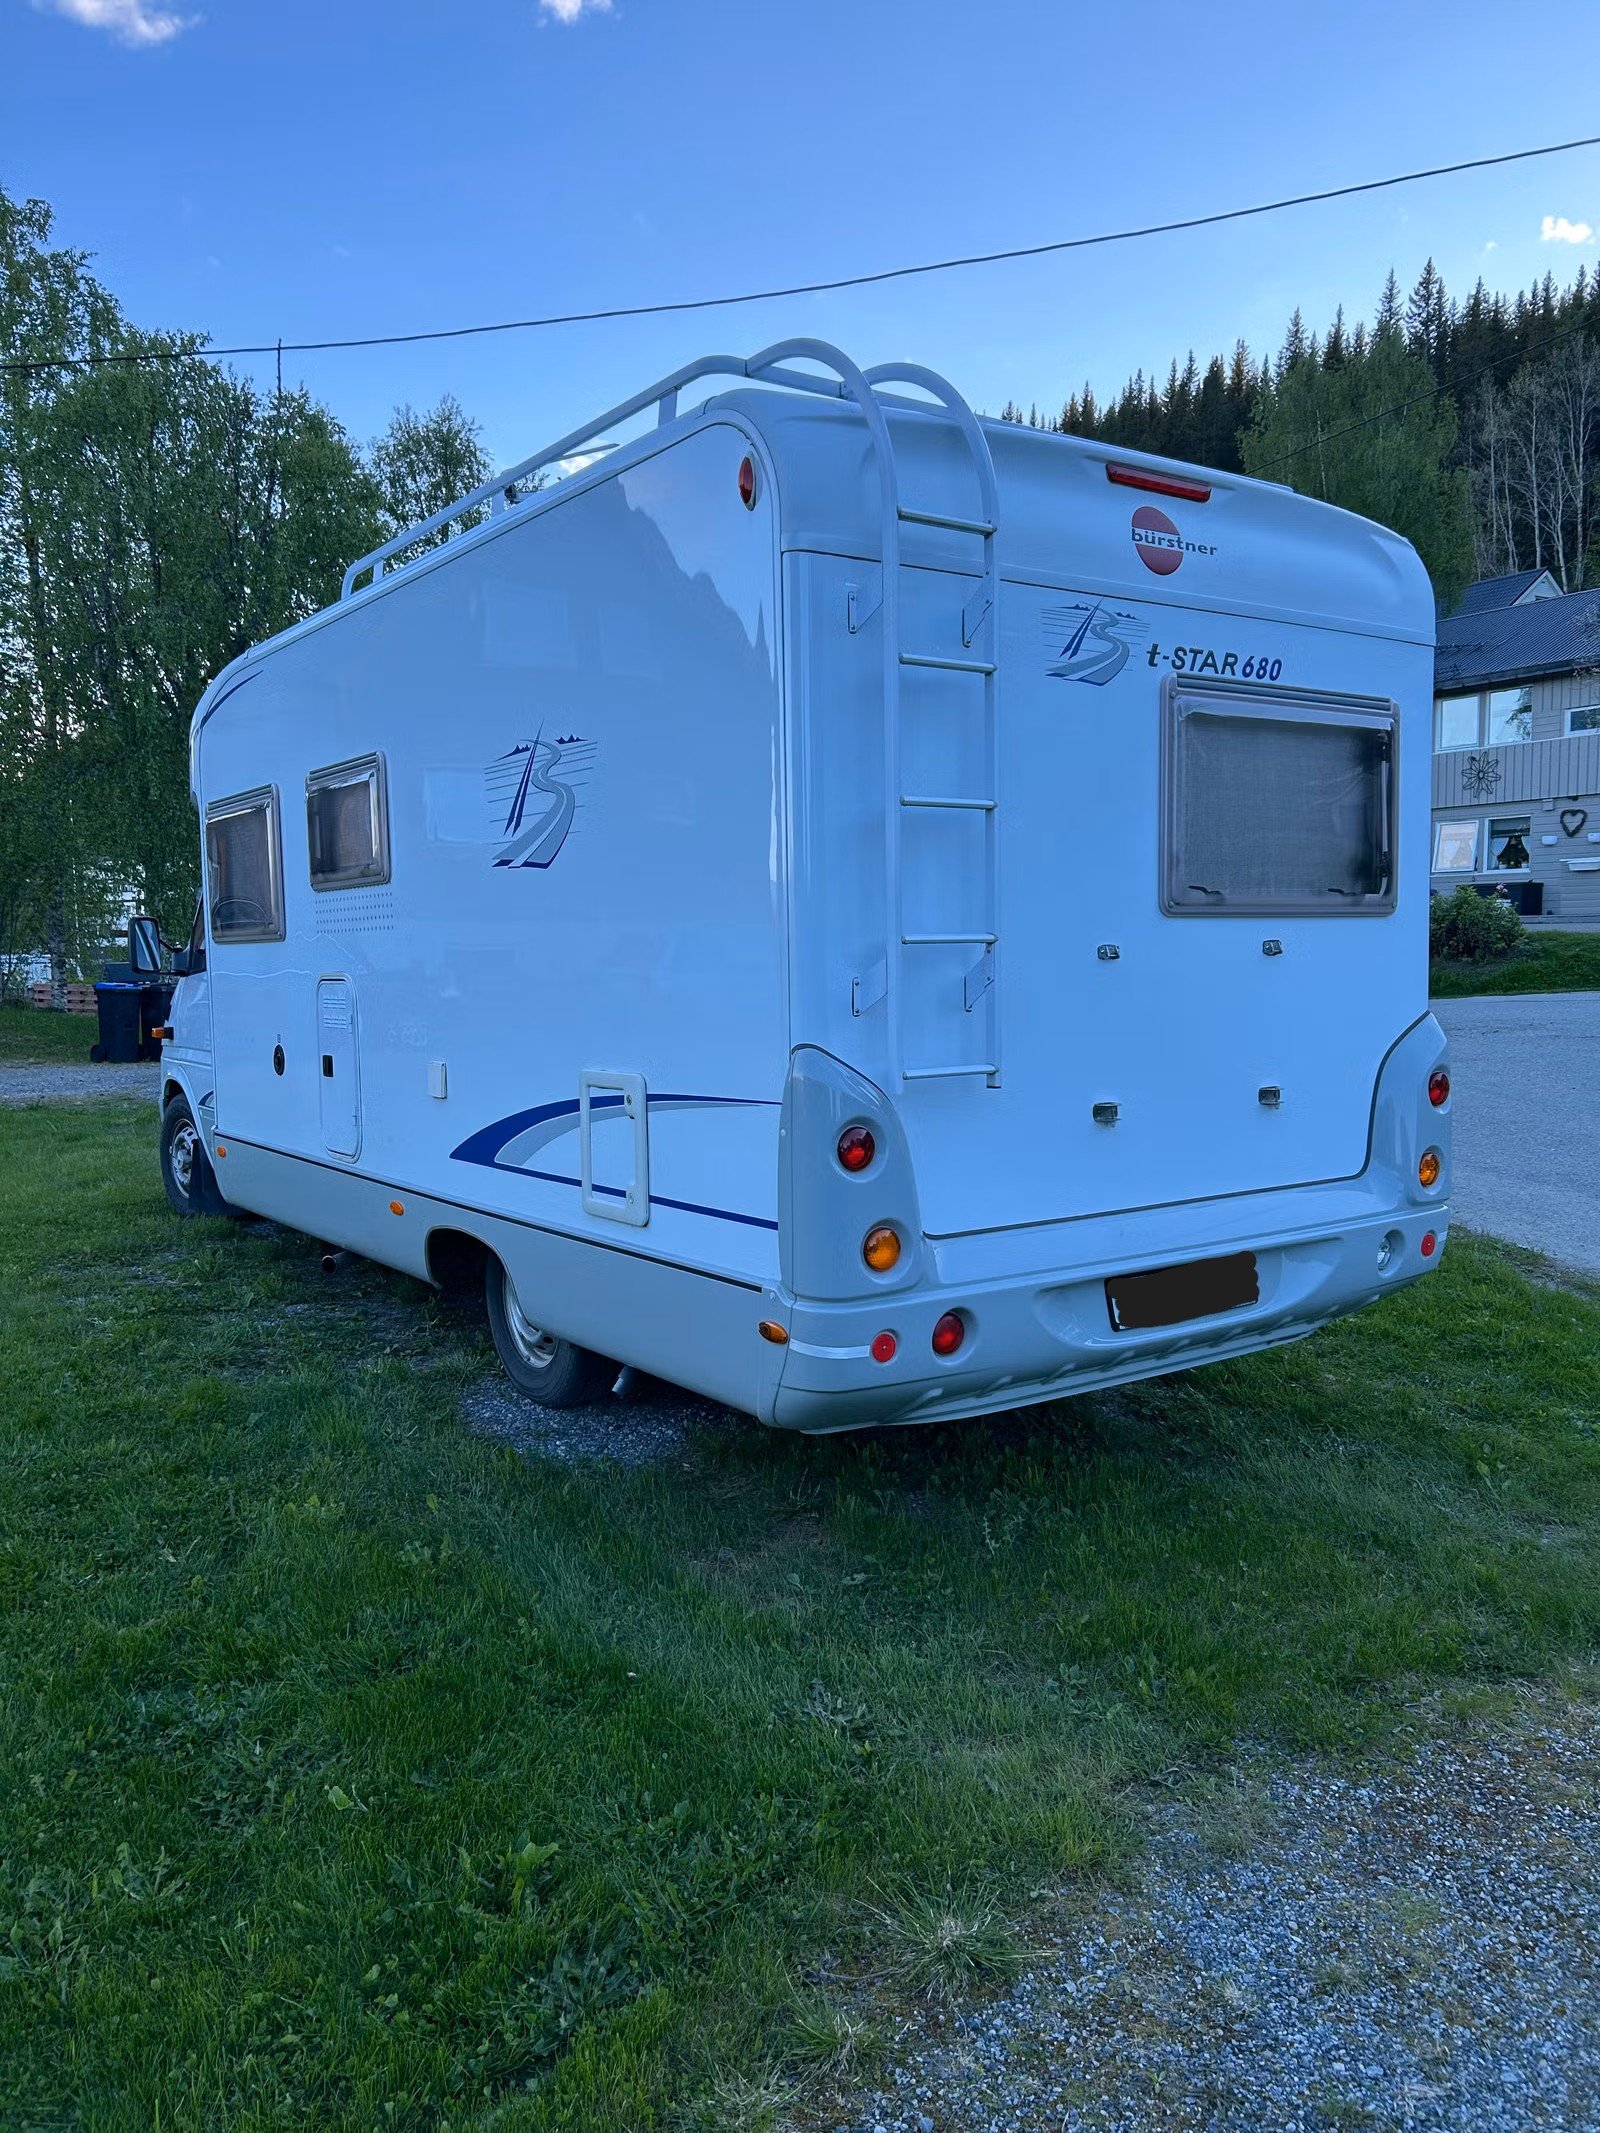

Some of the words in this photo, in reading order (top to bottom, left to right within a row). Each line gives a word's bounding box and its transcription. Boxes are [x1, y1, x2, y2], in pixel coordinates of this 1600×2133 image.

[1131, 528, 1217, 556] bürstner
[1147, 643, 1238, 676] t-STAR
[1241, 655, 1283, 681] 680
